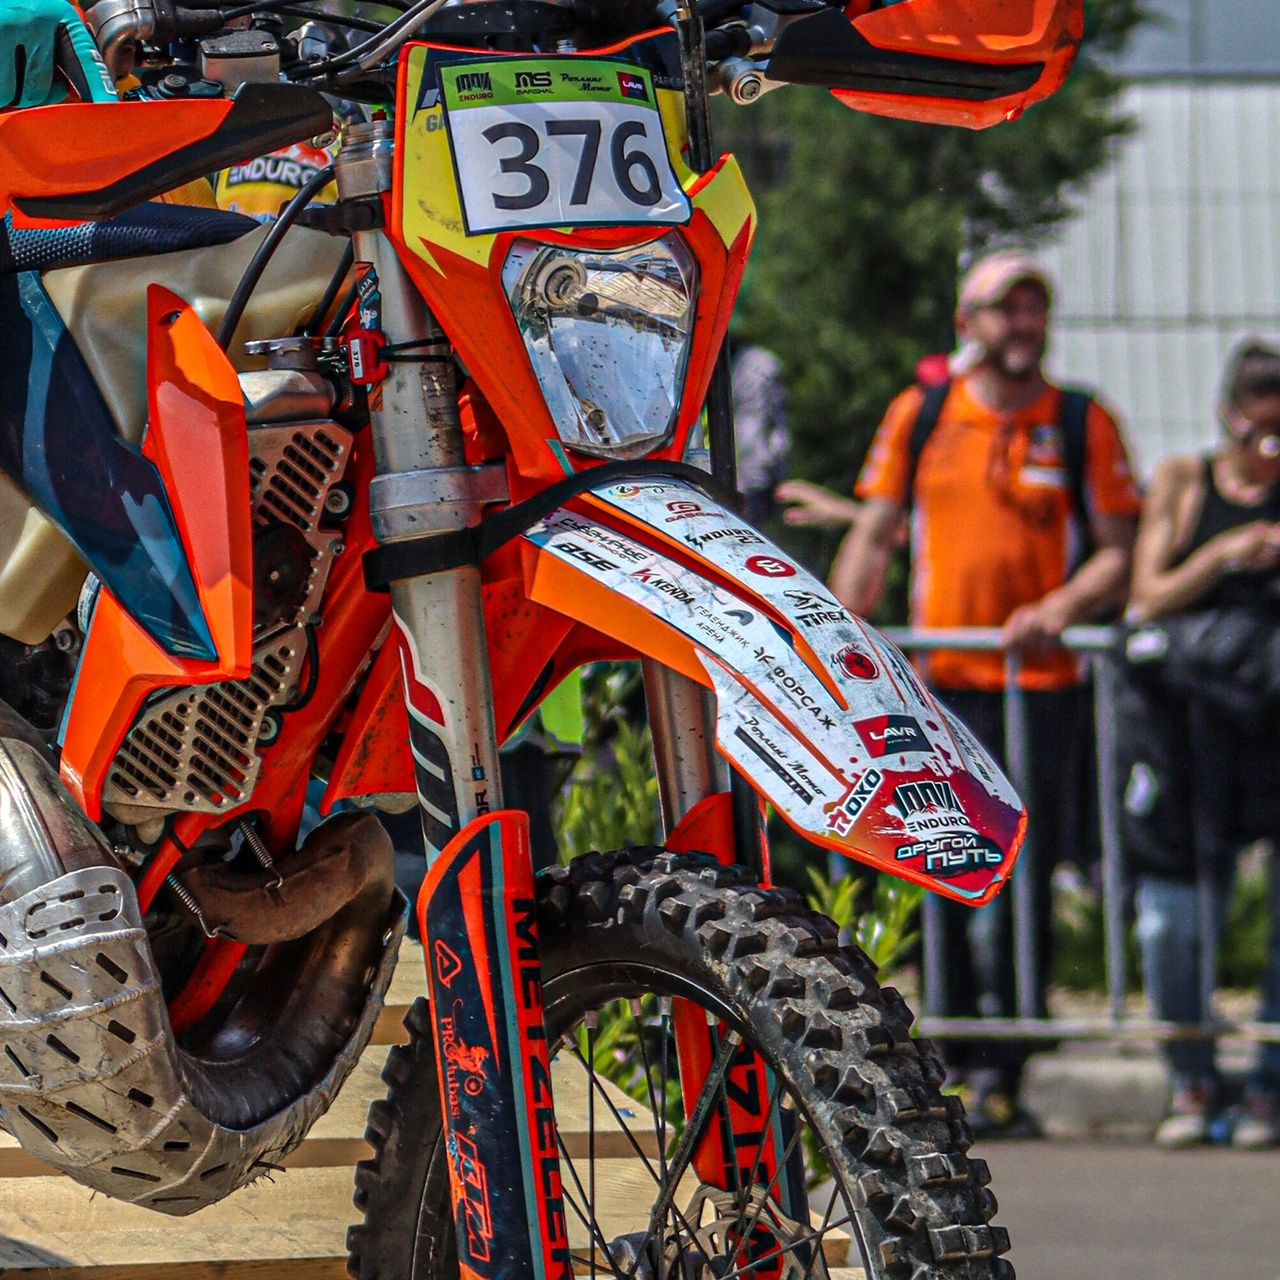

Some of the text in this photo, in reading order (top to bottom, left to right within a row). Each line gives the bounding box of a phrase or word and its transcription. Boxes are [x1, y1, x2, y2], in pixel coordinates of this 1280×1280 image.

[458, 92, 494, 102] ENDURO
[515, 88, 554, 96] MARSHAL
[481, 118, 663, 211] 376
[650, 578, 696, 605] KENDA
[694, 606, 751, 648] ГЕЛЕНДЖИК
[695, 622, 725, 644] АРЕНА
[774, 667, 837, 731] ФОРСАЖ
[870, 726, 917, 741] LAVR
[826, 767, 882, 833] ROKO
[906, 816, 970, 834] ENDURO
[897, 834, 977, 859] ДРУГОЙ
[926, 849, 1003, 871] ПУТЬ
